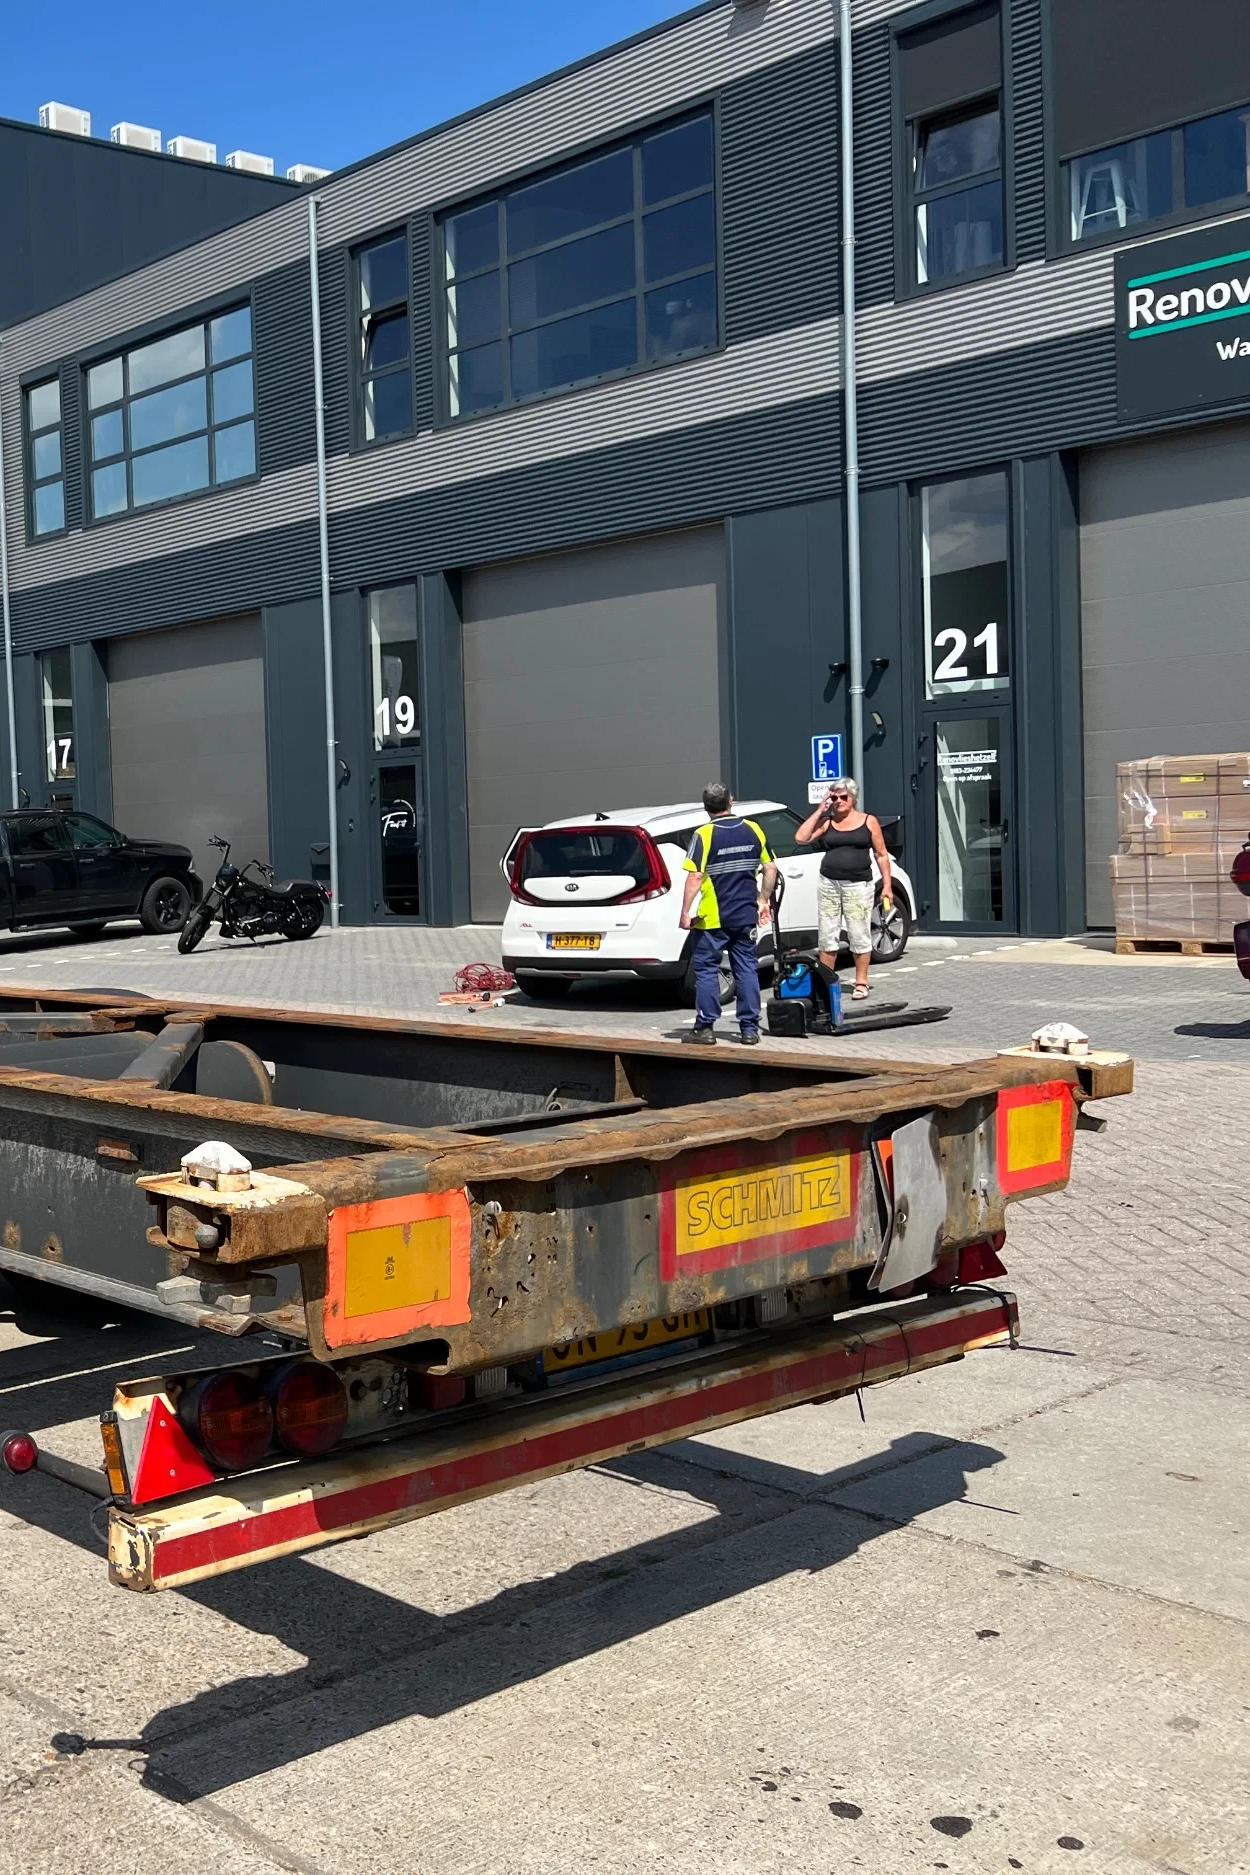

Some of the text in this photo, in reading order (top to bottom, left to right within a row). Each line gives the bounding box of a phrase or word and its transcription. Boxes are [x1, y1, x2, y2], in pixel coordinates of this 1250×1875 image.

[1129, 276, 1250, 329] Renov
[934, 622, 998, 680] 21
[376, 695, 415, 736] 19
[47, 738, 72, 770] 17
[817, 739, 834, 762] P
[688, 1165, 841, 1236] SCHMITZ
